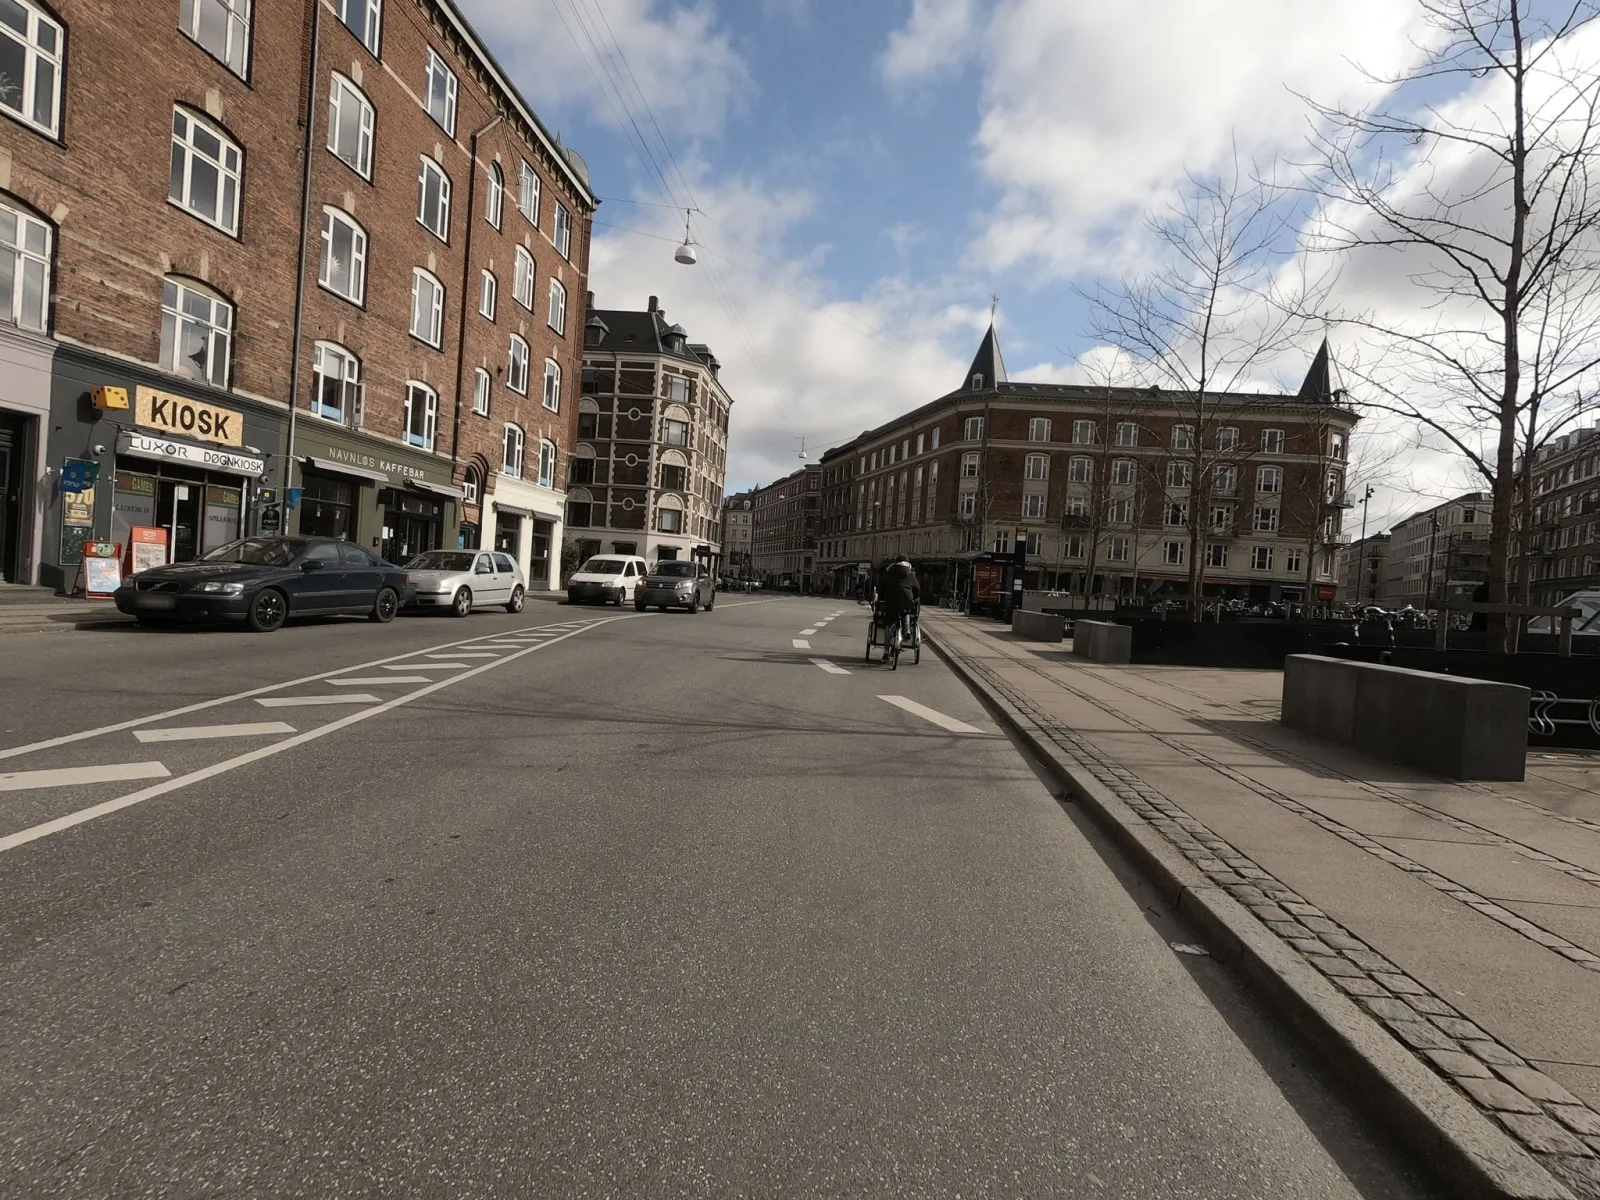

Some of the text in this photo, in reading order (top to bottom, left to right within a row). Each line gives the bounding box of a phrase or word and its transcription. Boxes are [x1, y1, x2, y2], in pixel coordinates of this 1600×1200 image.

[151, 396, 229, 439] KIOSK
[130, 438, 263, 472] LUXOR DØGNKIOSK
[329, 448, 424, 479] NAVNLØS KAFFEBAR
[132, 477, 153, 493] GAMES
[115, 504, 142, 512] LUXOR
